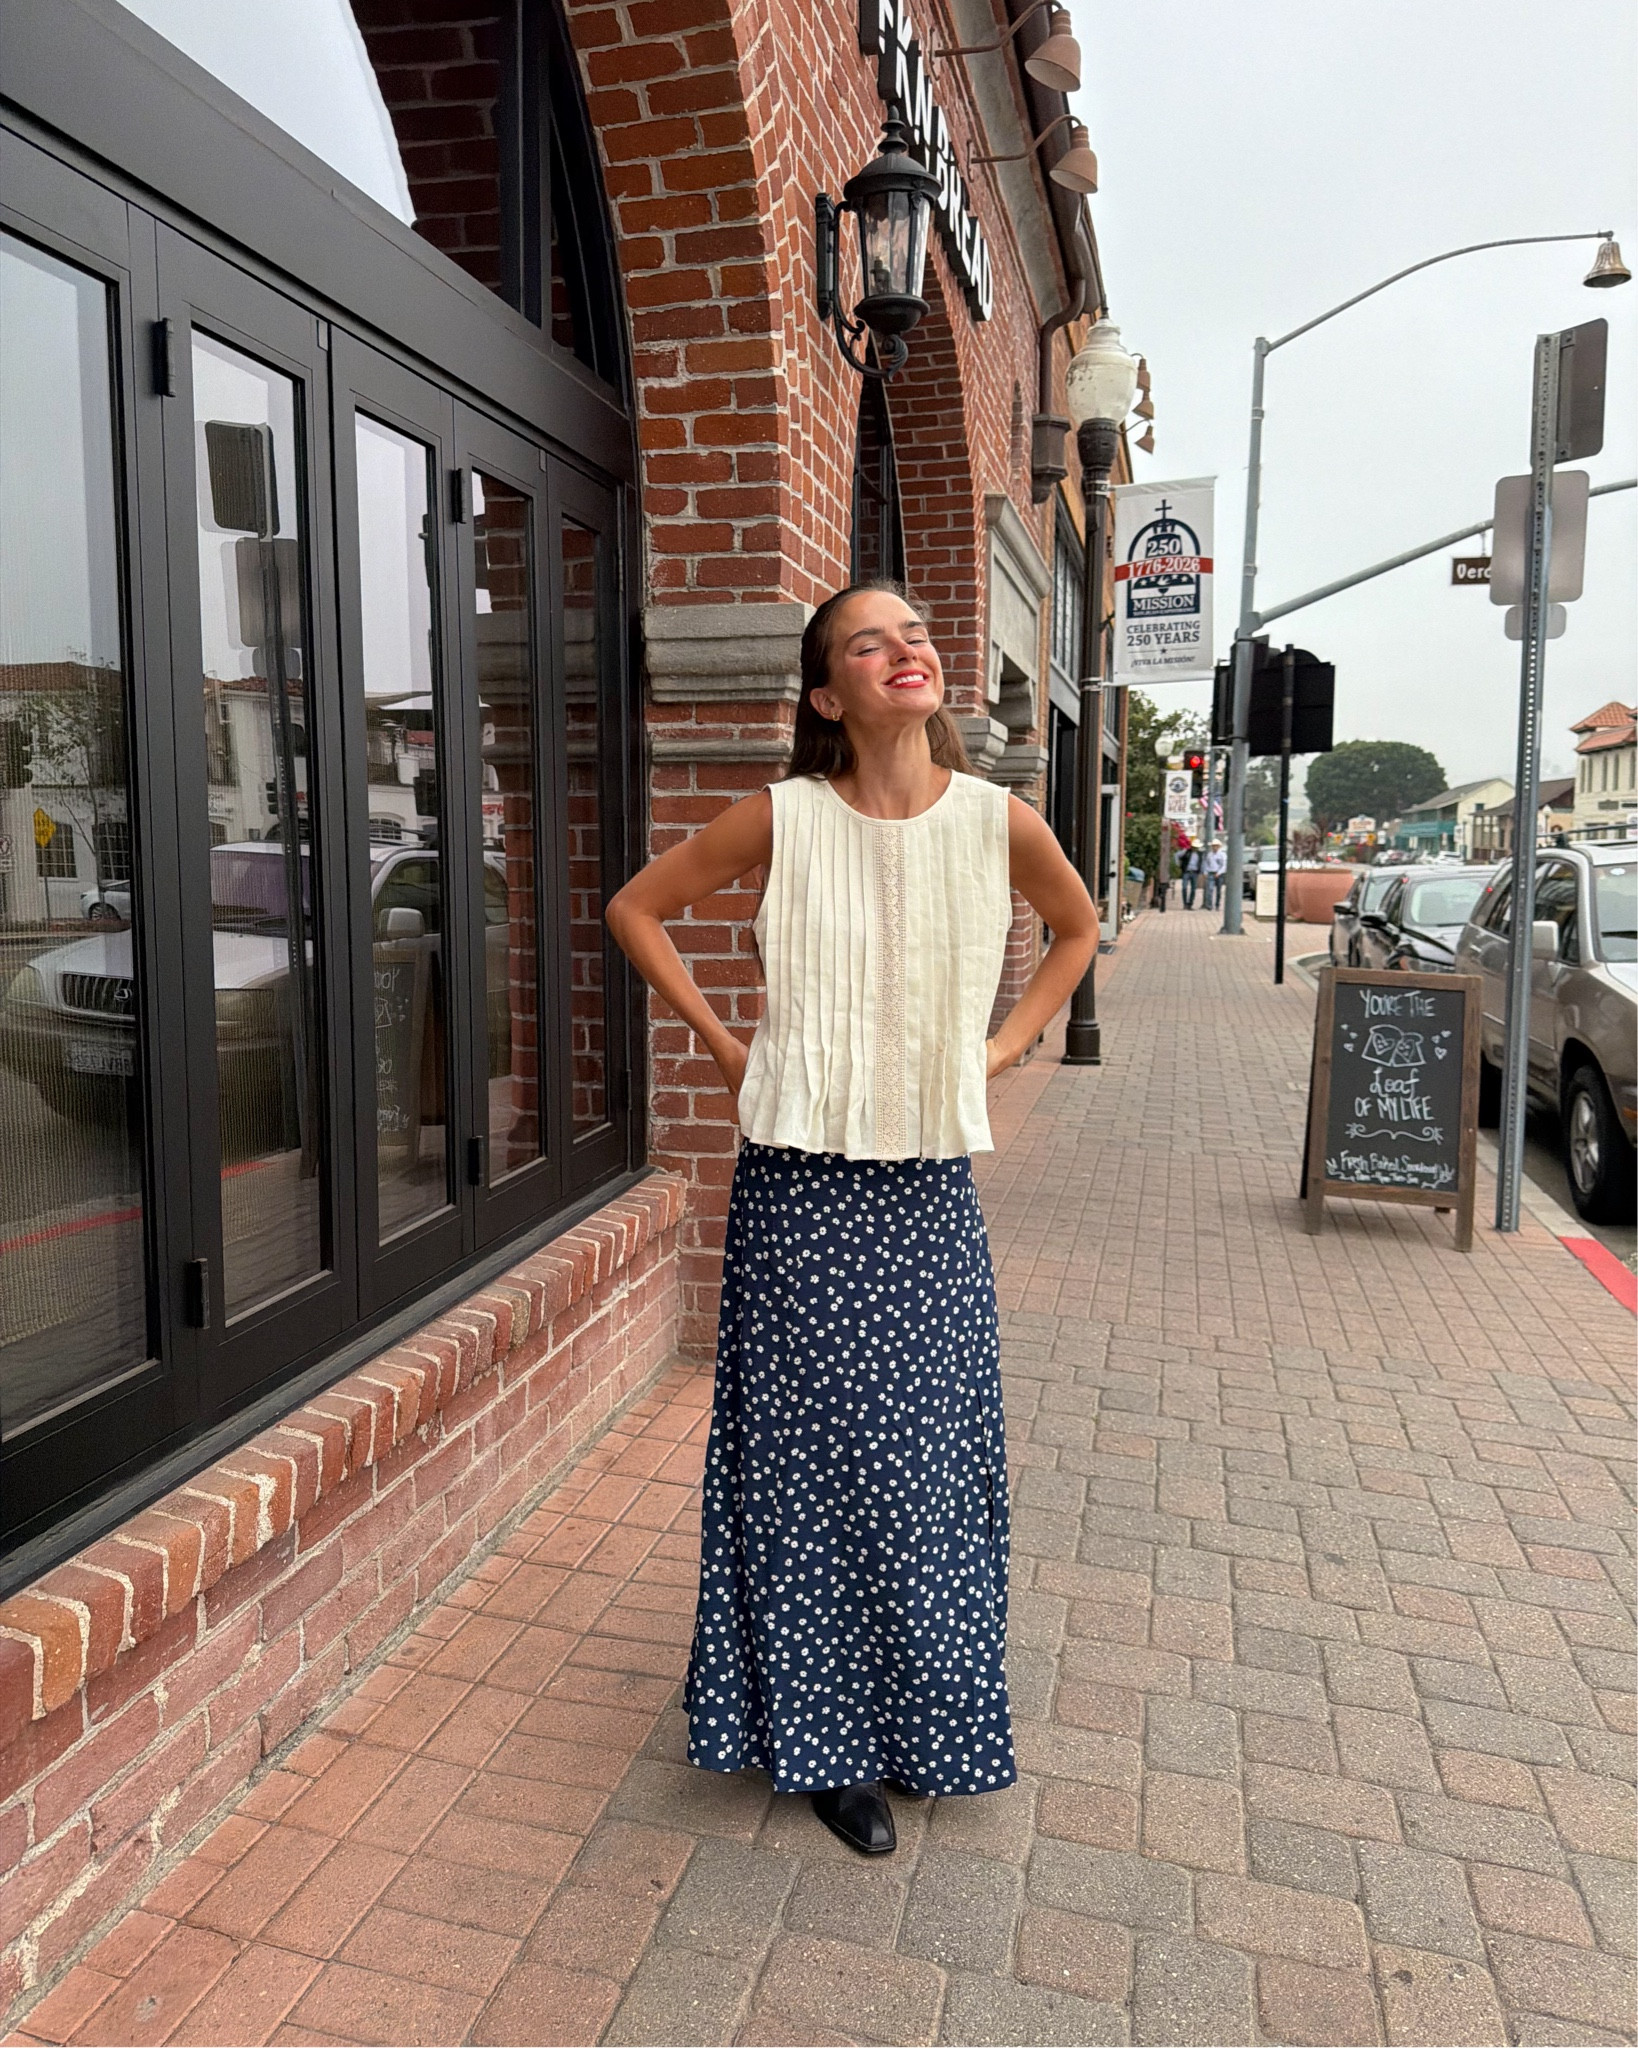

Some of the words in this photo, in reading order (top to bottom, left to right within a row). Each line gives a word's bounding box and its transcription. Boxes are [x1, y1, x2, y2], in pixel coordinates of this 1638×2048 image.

[936, 105, 993, 321] BREAD
[1147, 538, 1181, 557] 250
[1127, 557, 1200, 579] 1776-2026
[1132, 595, 1195, 611] MISSION
[1126, 620, 1200, 634] CELEBRATING
[1127, 634, 1151, 647] 250
[1154, 630, 1200, 645] YEARS
[1403, 990, 1436, 1017] THE
[1354, 1096, 1373, 1118] OF
[1377, 1096, 1399, 1121] MY
[1400, 1096, 1435, 1120] LIFE
